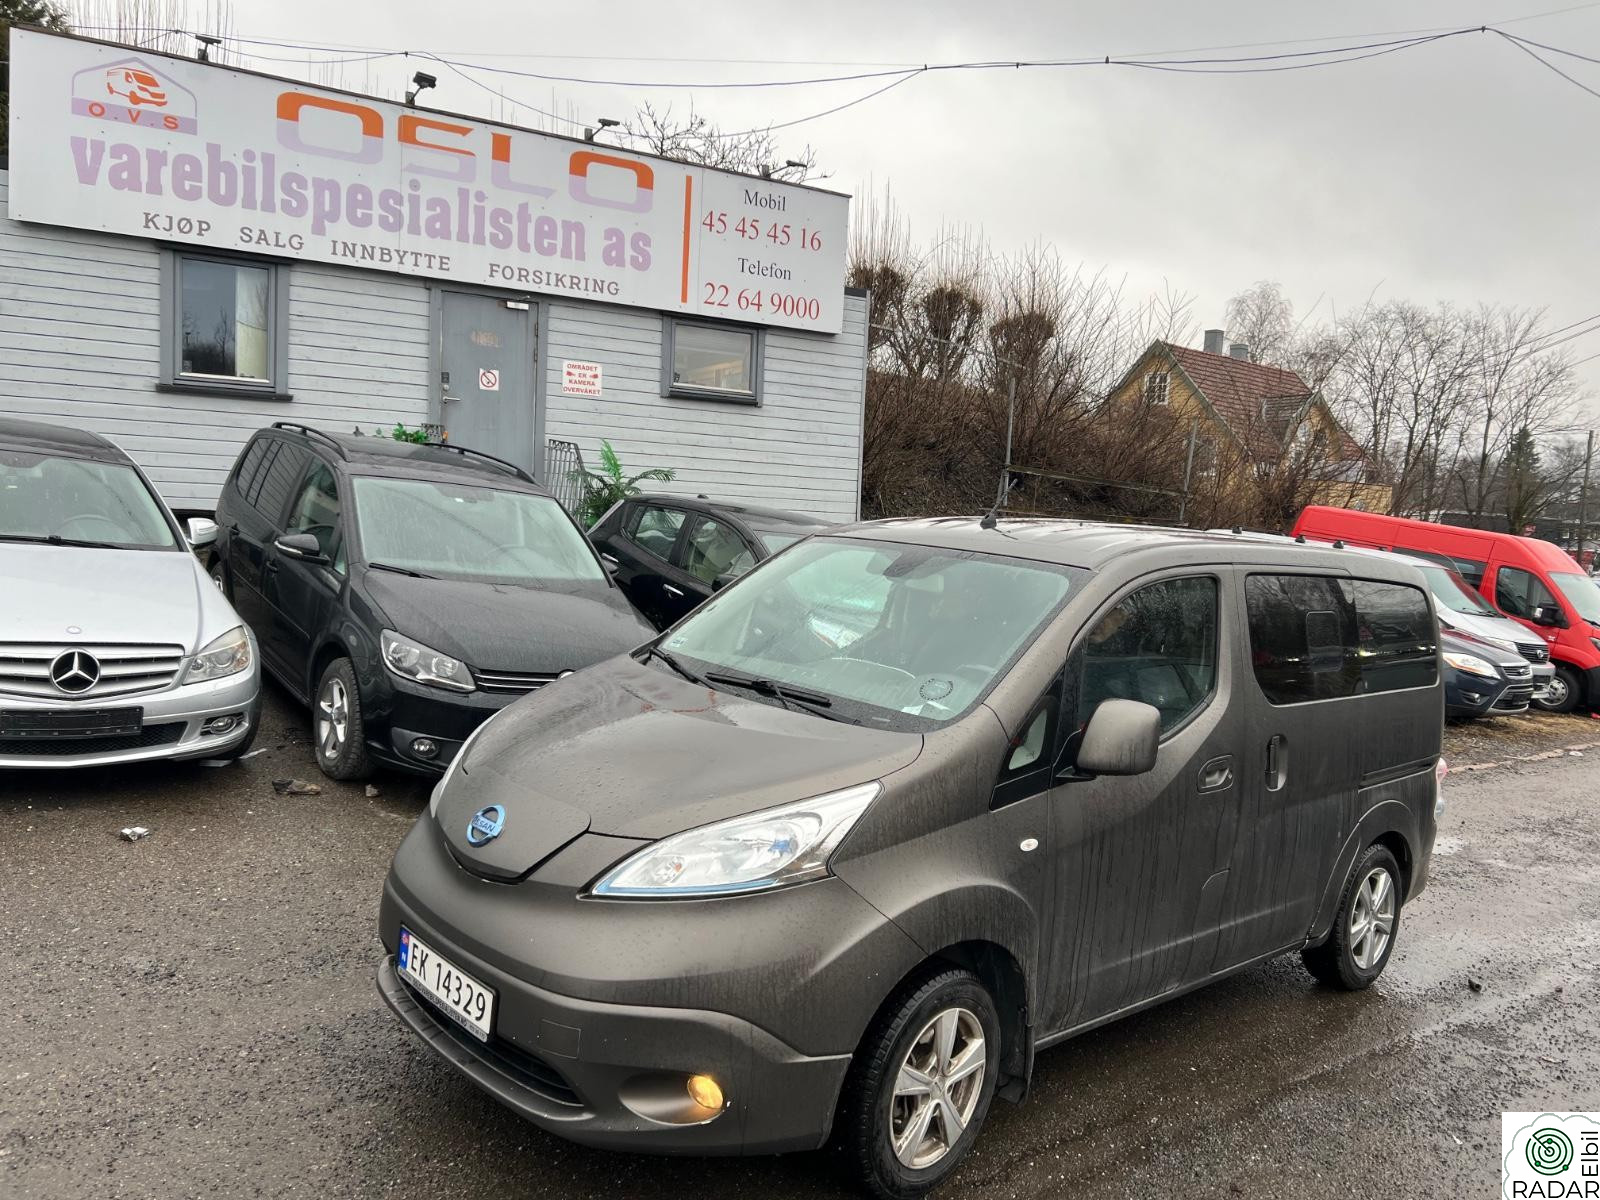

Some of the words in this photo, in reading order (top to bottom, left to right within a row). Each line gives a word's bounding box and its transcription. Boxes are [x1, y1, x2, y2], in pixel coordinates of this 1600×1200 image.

[276, 91, 655, 214] OSLO
[70, 135, 587, 262] varebilspesialisten
[602, 226, 653, 272] as
[702, 210, 728, 234] 45
[735, 216, 760, 240] 45
[766, 222, 791, 246] 45
[800, 228, 821, 252] 16
[744, 189, 786, 212] Mobil
[143, 212, 211, 237] KJØP
[239, 226, 305, 251] SALG
[331, 240, 451, 272] INNBYTTE
[488, 263, 620, 296] FORSIKRING
[738, 257, 791, 281] Telefon
[703, 282, 729, 307] 22
[737, 288, 763, 312] 64
[770, 292, 820, 321] 9000
[411, 942, 428, 982] EK
[436, 962, 486, 1022] 14329
